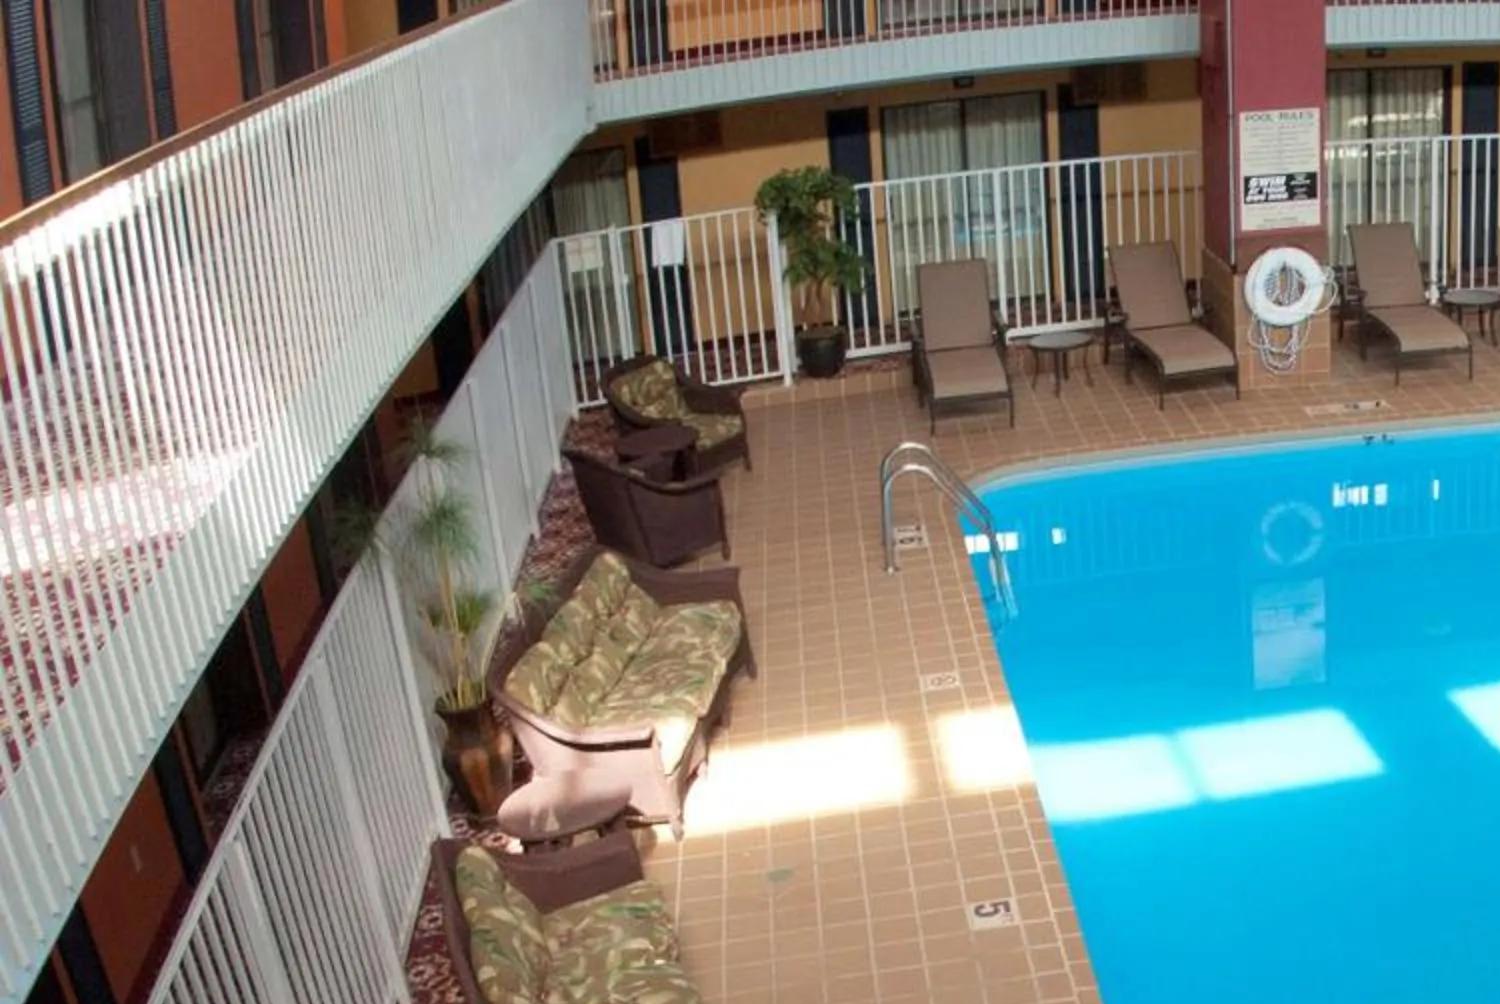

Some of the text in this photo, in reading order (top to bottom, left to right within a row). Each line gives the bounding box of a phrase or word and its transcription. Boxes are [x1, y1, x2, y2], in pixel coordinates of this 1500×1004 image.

[1244, 110, 1314, 123] POOL RULES
[1248, 175, 1287, 188] SWIM
[974, 900, 1011, 918] 5
